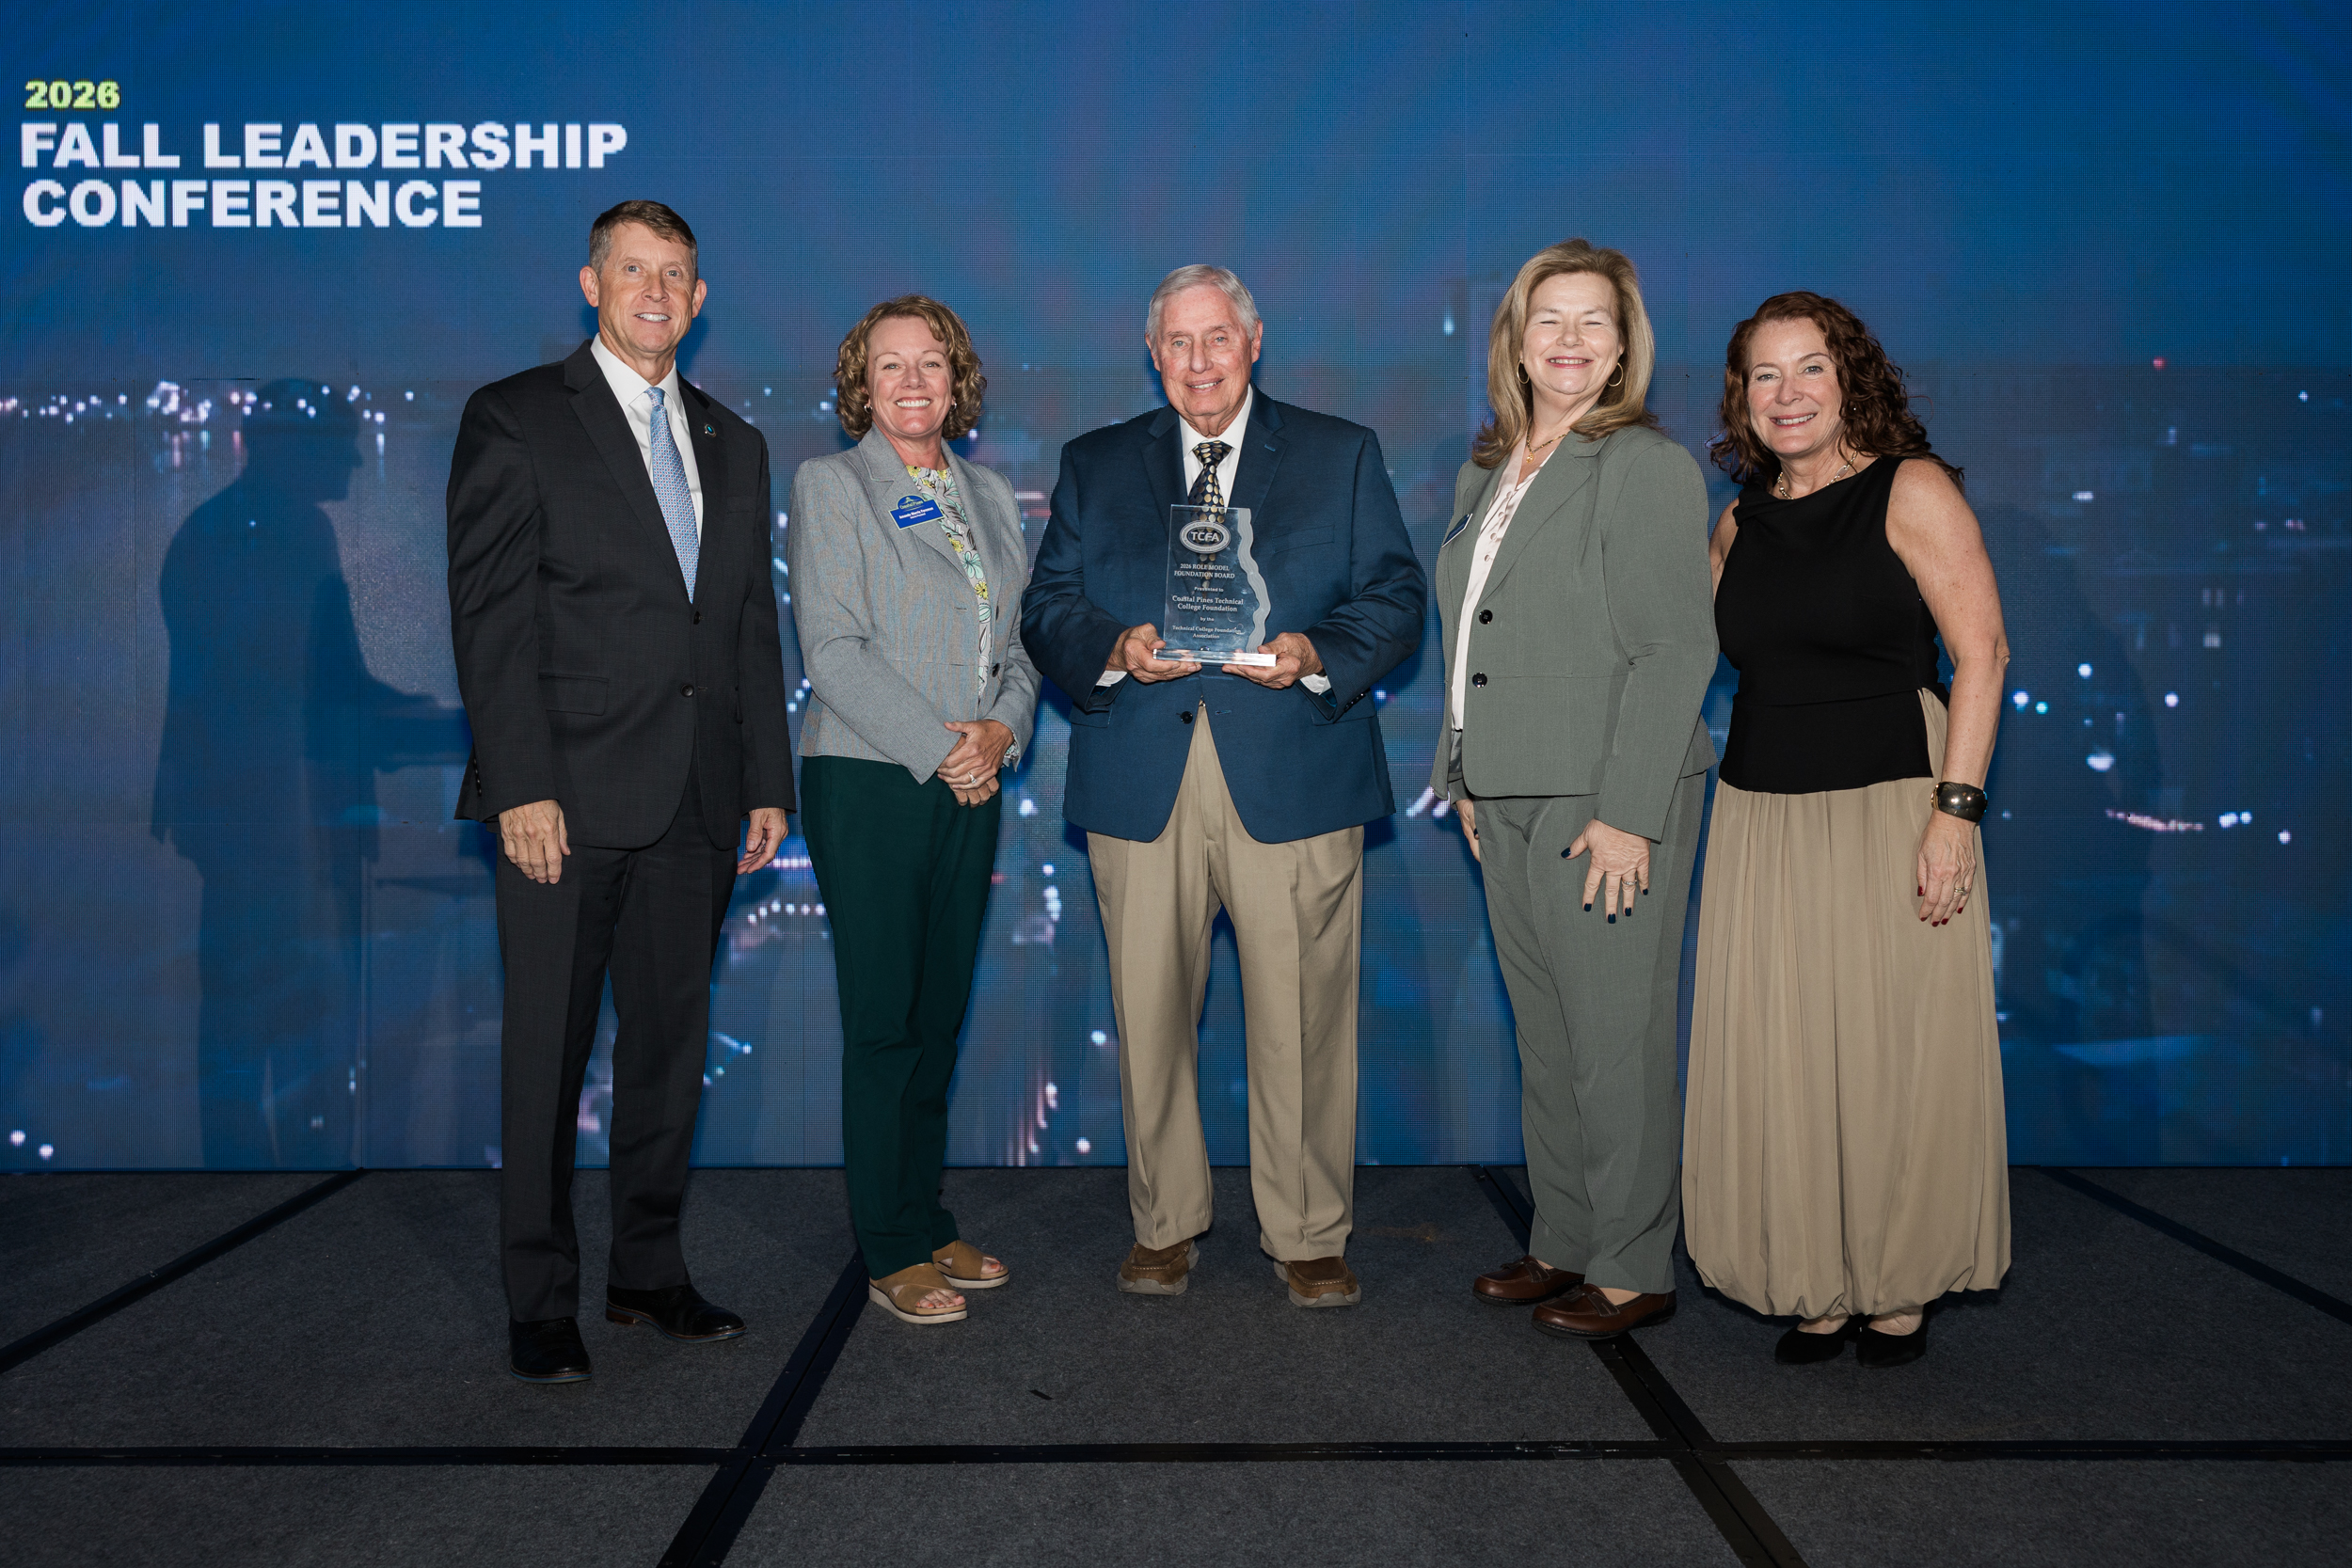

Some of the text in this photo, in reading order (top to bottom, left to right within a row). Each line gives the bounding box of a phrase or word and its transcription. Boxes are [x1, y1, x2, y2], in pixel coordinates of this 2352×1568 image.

[24, 80, 120, 109] 2026
[21, 121, 628, 170] FALL LEADERSHIP
[23, 180, 483, 228] CONFERENCE
[1190, 531, 1219, 542] TCFA
[1177, 603, 1238, 612] College Foundation
